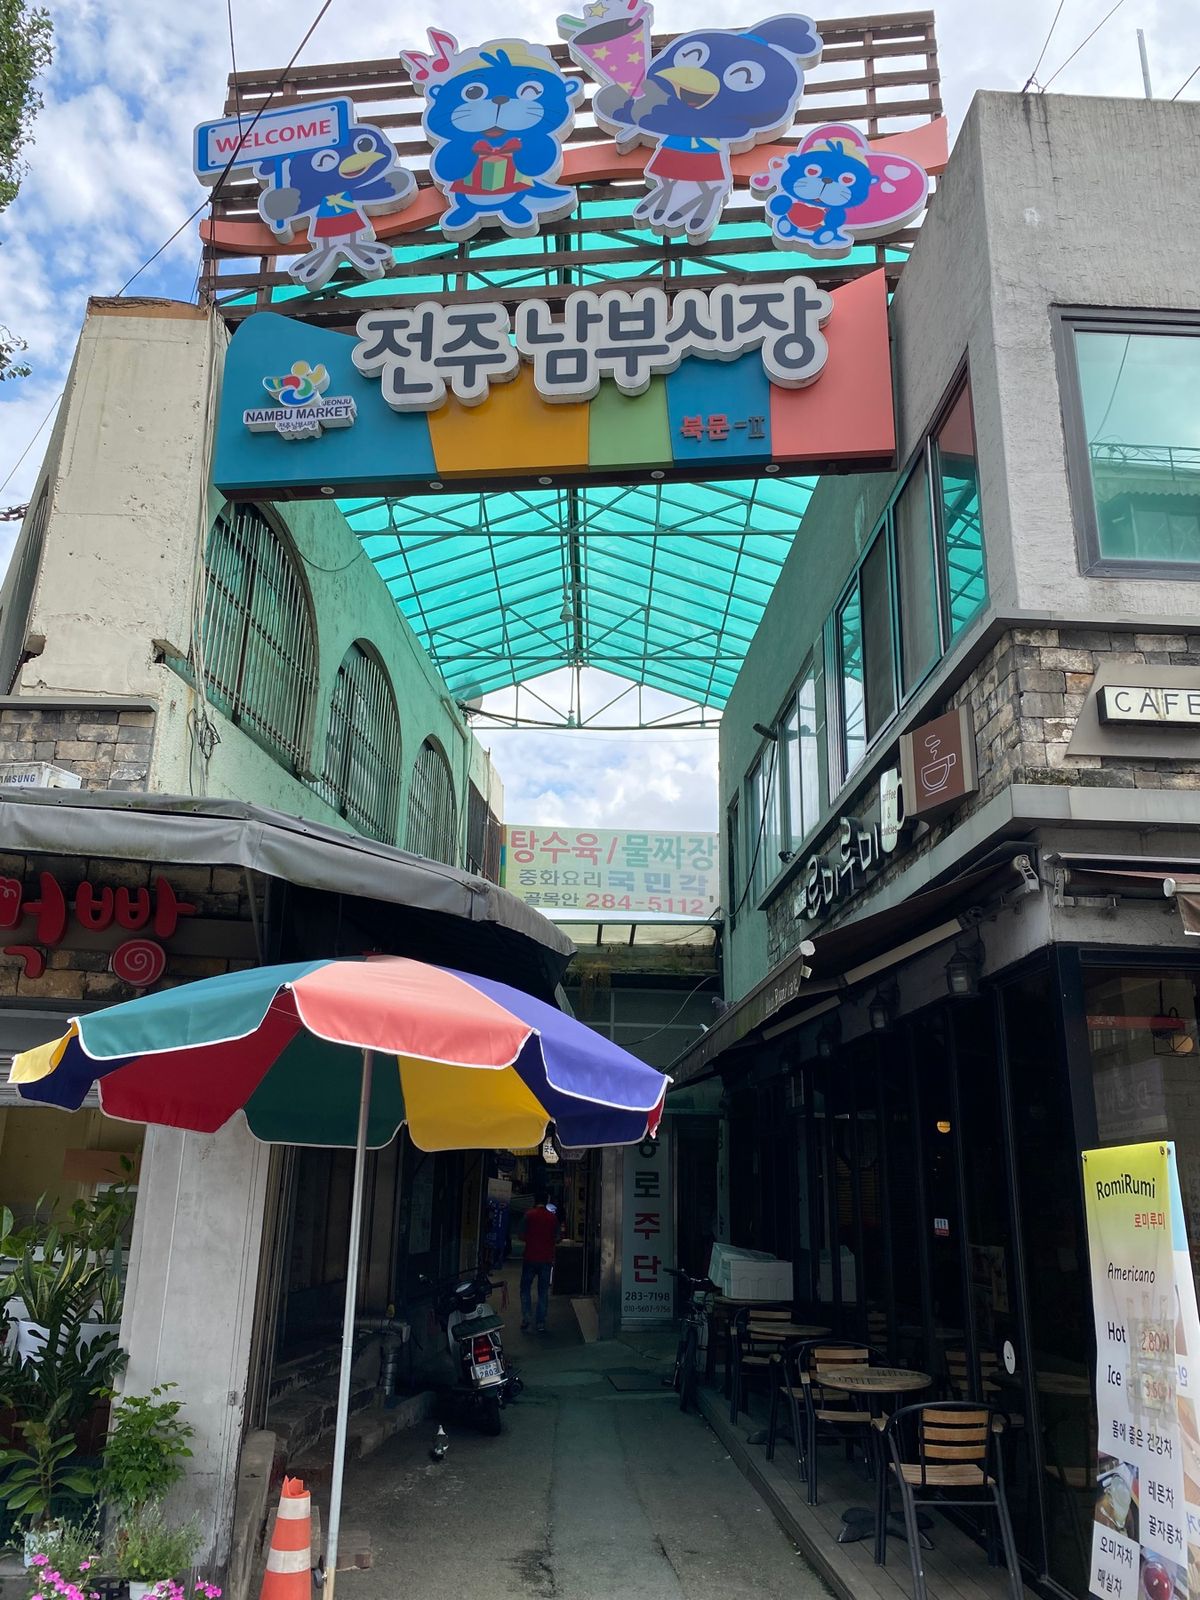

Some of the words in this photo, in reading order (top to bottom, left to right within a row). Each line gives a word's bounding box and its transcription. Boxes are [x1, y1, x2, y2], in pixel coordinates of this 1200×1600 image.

[215, 119, 332, 153] WELCOME
[245, 409, 293, 422] NAMBU
[296, 405, 351, 419] MARKET
[323, 398, 351, 406] JEONJU
[519, 868, 602, 888] 중화요리
[607, 870, 709, 896] 국민각
[523, 891, 580, 907] 골목안
[585, 892, 704, 914] 284-5112
[1096, 1173, 1156, 1200] RomiRumi
[1134, 1212, 1166, 1230] 로미루미
[1107, 1261, 1156, 1284] Americano
[625, 1291, 670, 1301] 283-7198
[1107, 1321, 1126, 1344] Hot
[1107, 1364, 1122, 1386] Ice
[1111, 1419, 1127, 1442] 몸에
[1128, 1426, 1143, 1448] 좋은
[1146, 1432, 1173, 1460] 건강차
[1148, 1480, 1175, 1509] 레몬차
[1148, 1514, 1183, 1550] 꿀자몽차
[1099, 1535, 1133, 1569] 오미자차
